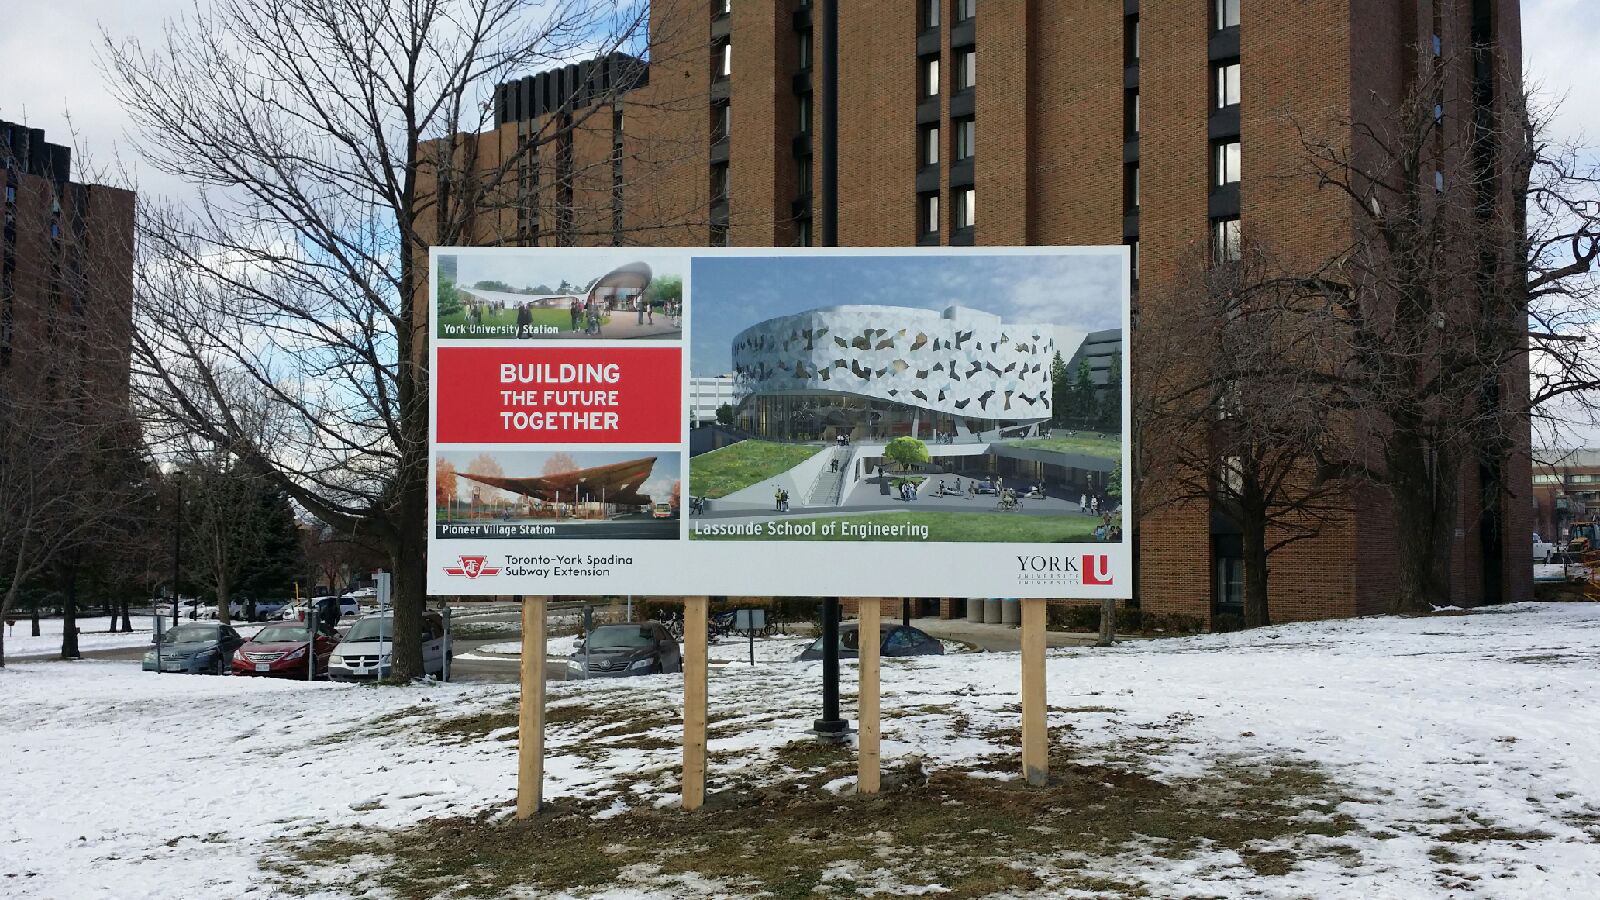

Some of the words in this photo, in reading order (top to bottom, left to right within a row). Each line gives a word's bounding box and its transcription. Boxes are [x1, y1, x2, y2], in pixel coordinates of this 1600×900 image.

[444, 324, 466, 334] York
[469, 324, 520, 337] University
[522, 324, 559, 334] Station
[500, 363, 620, 384] BUILDING
[500, 390, 538, 406] THE
[543, 390, 619, 407] FUTURE
[500, 411, 619, 431] TOGETHER
[442, 524, 480, 534] Pioneer
[483, 524, 517, 537] Village
[519, 525, 556, 535] Station
[694, 520, 763, 536] Lassonde
[767, 521, 816, 536] School
[821, 521, 837, 536] of
[841, 521, 929, 540] Engineering
[505, 554, 583, 566] Toronto-York
[586, 554, 633, 568] Spadina
[1016, 555, 1079, 572] YORK
[505, 566, 551, 579] Subway
[553, 566, 610, 577] Extension
